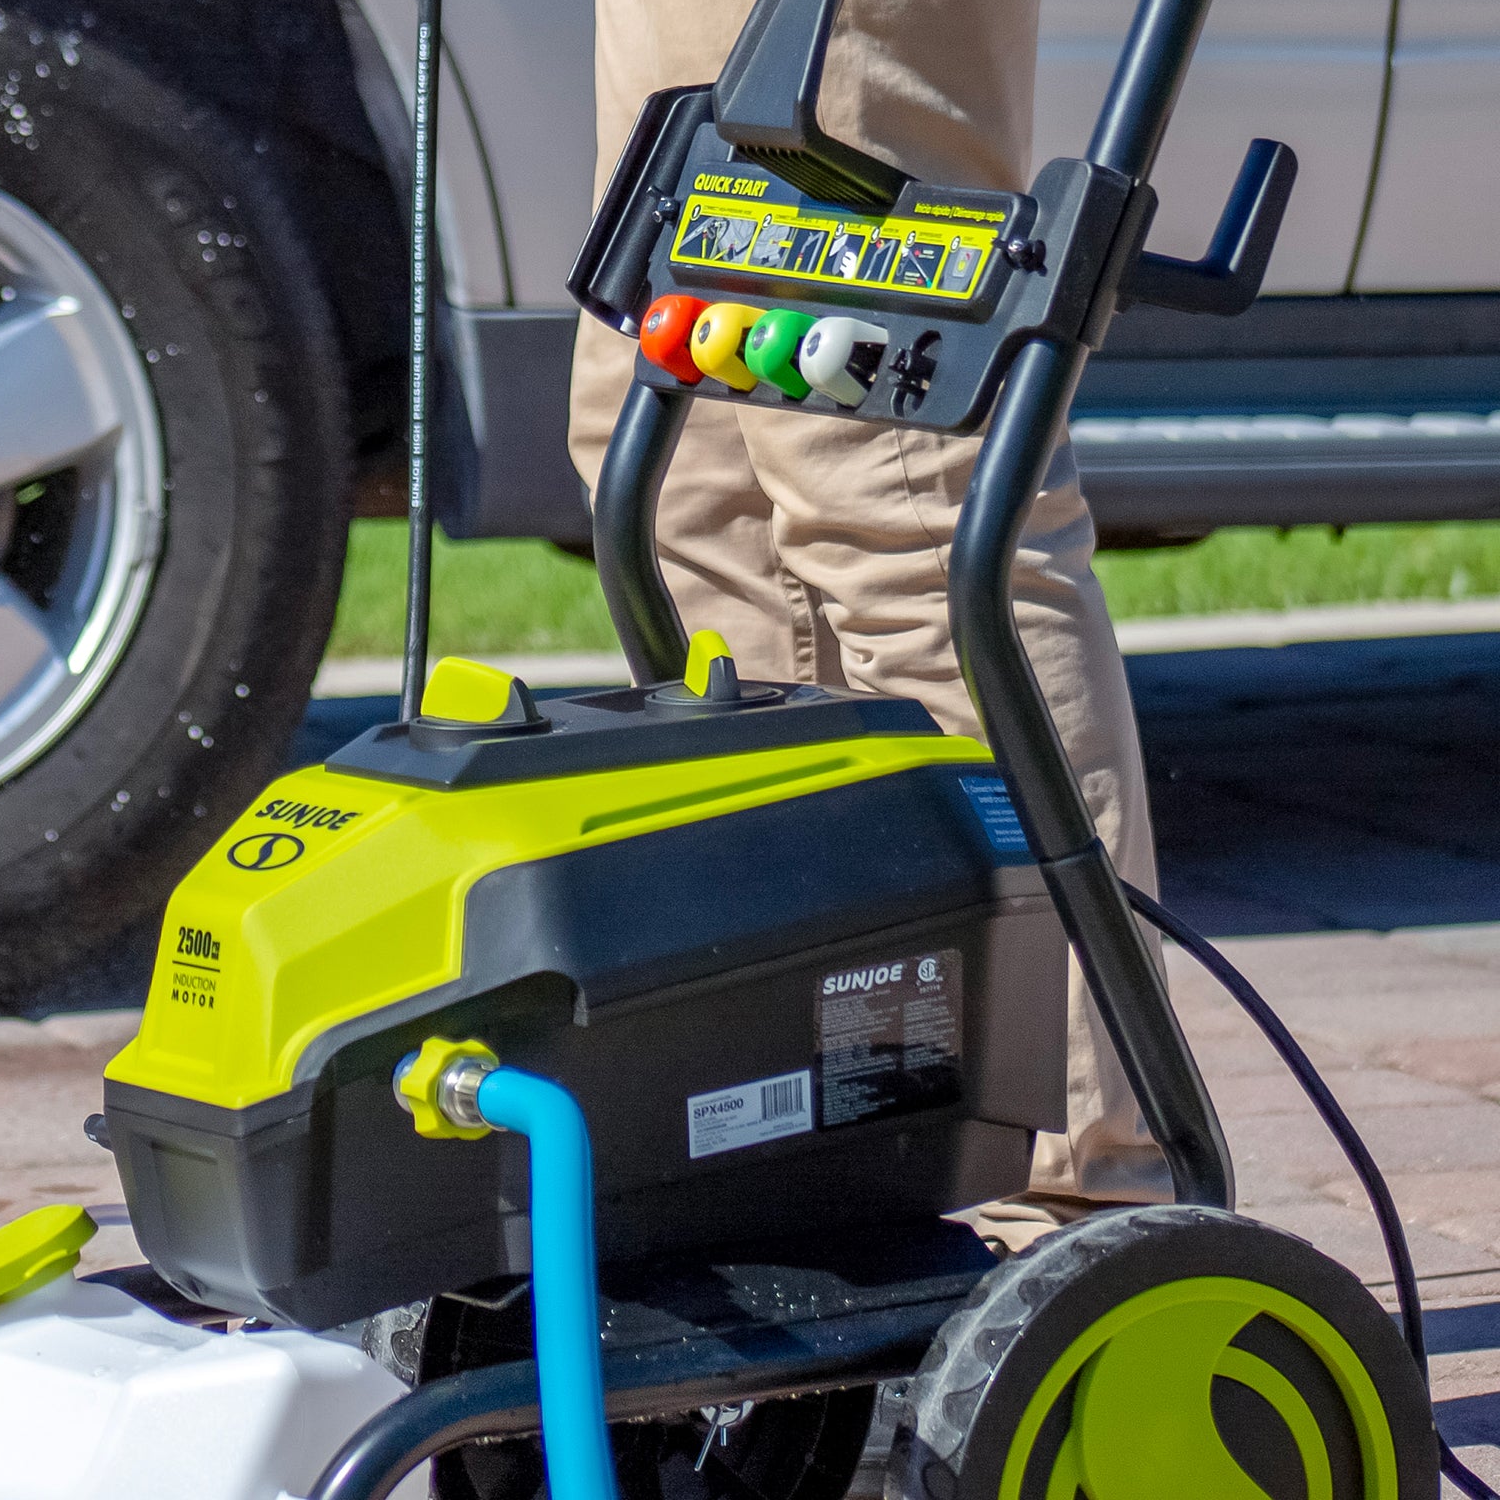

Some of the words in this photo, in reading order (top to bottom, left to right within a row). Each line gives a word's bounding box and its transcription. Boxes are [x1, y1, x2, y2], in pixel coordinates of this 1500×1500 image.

[417, 95, 426, 123] MAX
[416, 130, 425, 150] PSI
[694, 173, 733, 193] QUICK
[732, 178, 769, 197] START
[415, 186, 424, 211] MPA
[415, 213, 423, 227] 20
[414, 235, 423, 260] BAR
[414, 261, 423, 282] 200
[414, 285, 423, 313] MAX
[414, 317, 423, 351] HOSE
[412, 355, 422, 420] PRESSURE
[412, 424, 422, 454] HIGH
[411, 459, 421, 508] SUNJOE
[255, 799, 359, 830] SUNJOE
[177, 926, 212, 959] 2500
[173, 972, 216, 991] INDUCTION
[823, 964, 903, 995] SUNJOE
[171, 988, 214, 1009] MOTOR
[693, 1098, 744, 1119] SPX4500
